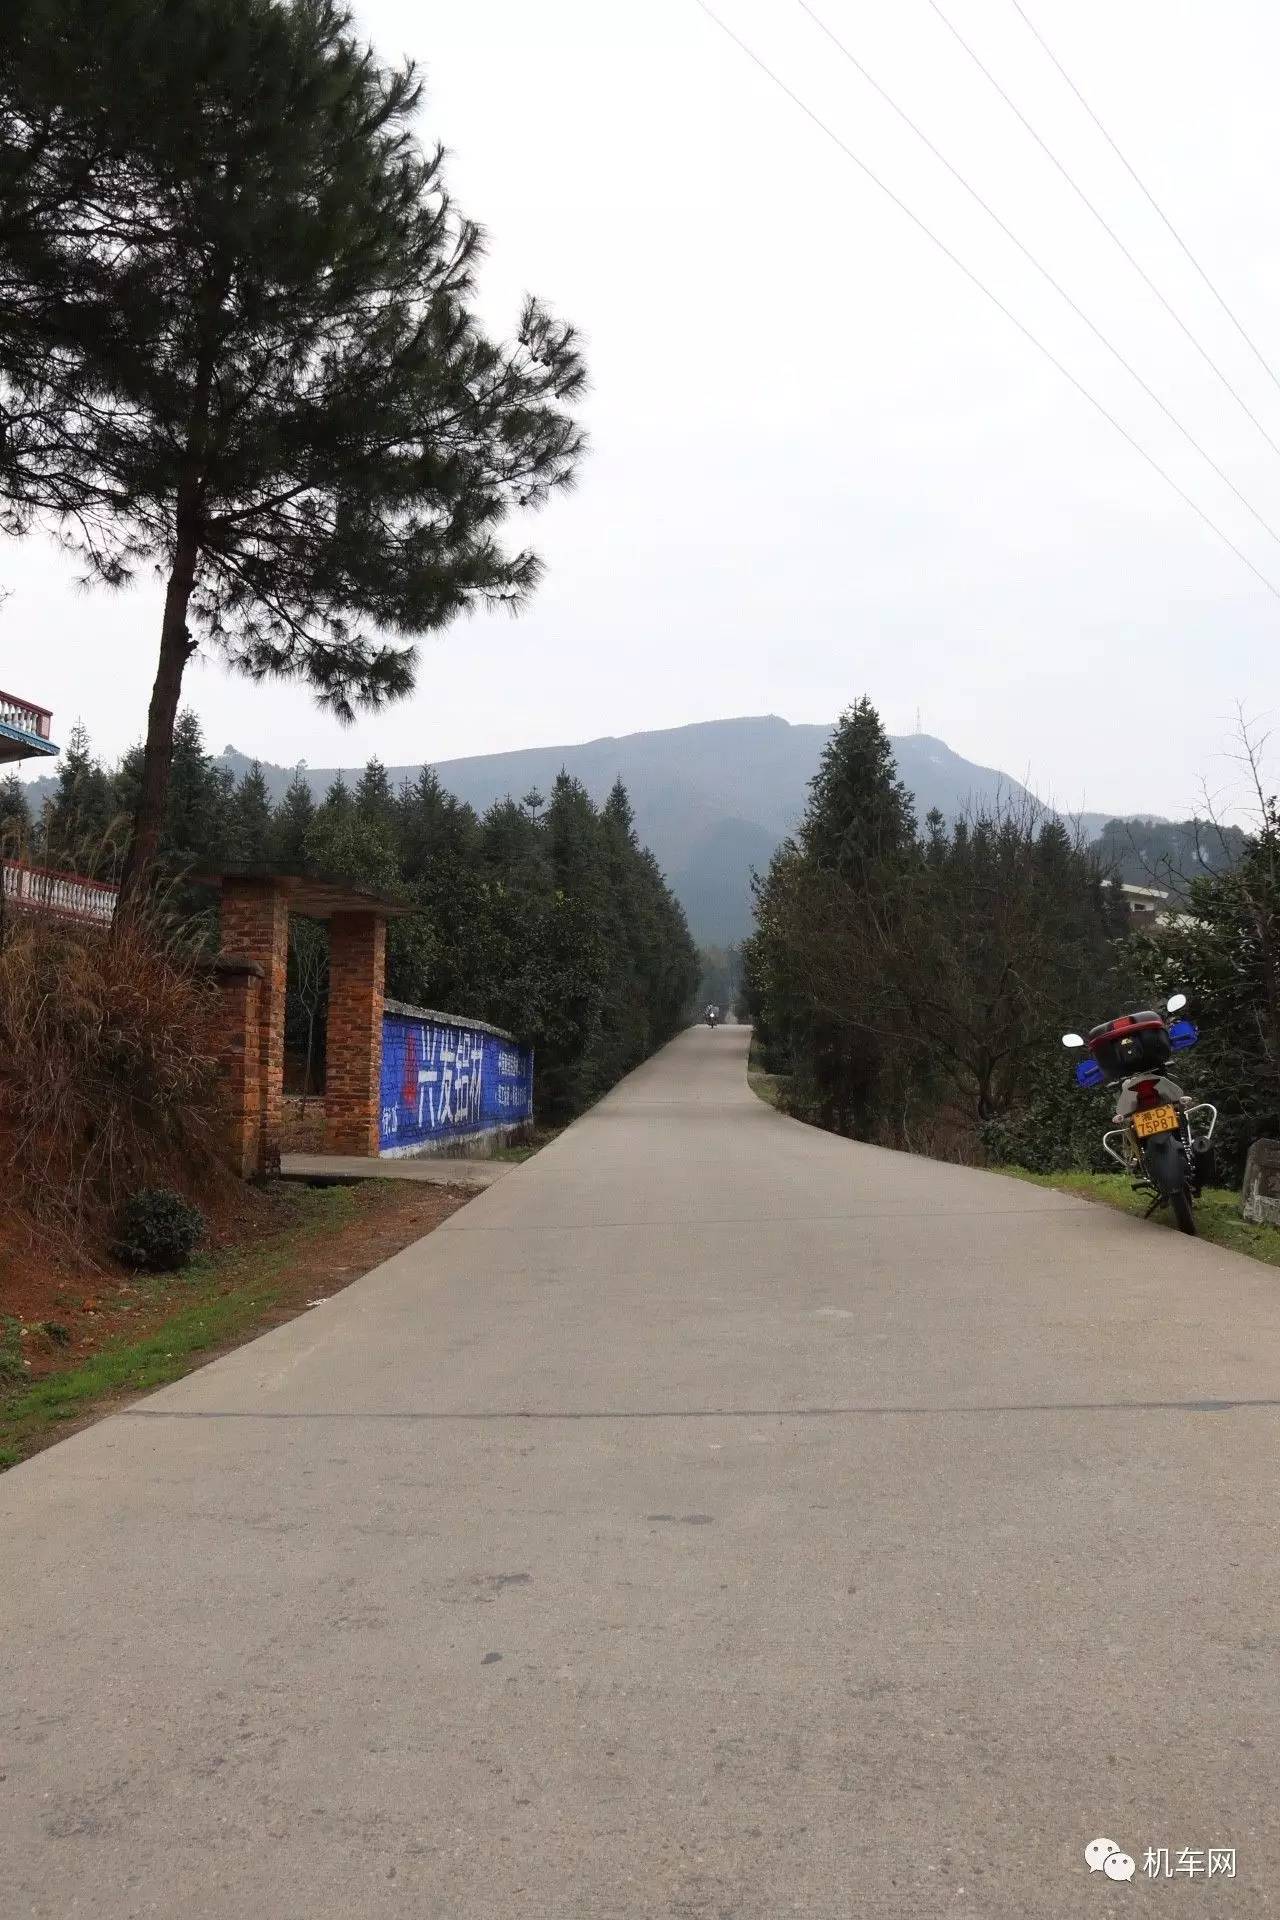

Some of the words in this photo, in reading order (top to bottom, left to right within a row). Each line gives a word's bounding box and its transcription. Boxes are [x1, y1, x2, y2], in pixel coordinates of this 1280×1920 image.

[418, 1025, 484, 1128] 兴发铝材
[1138, 1116, 1174, 1135] 75P87
